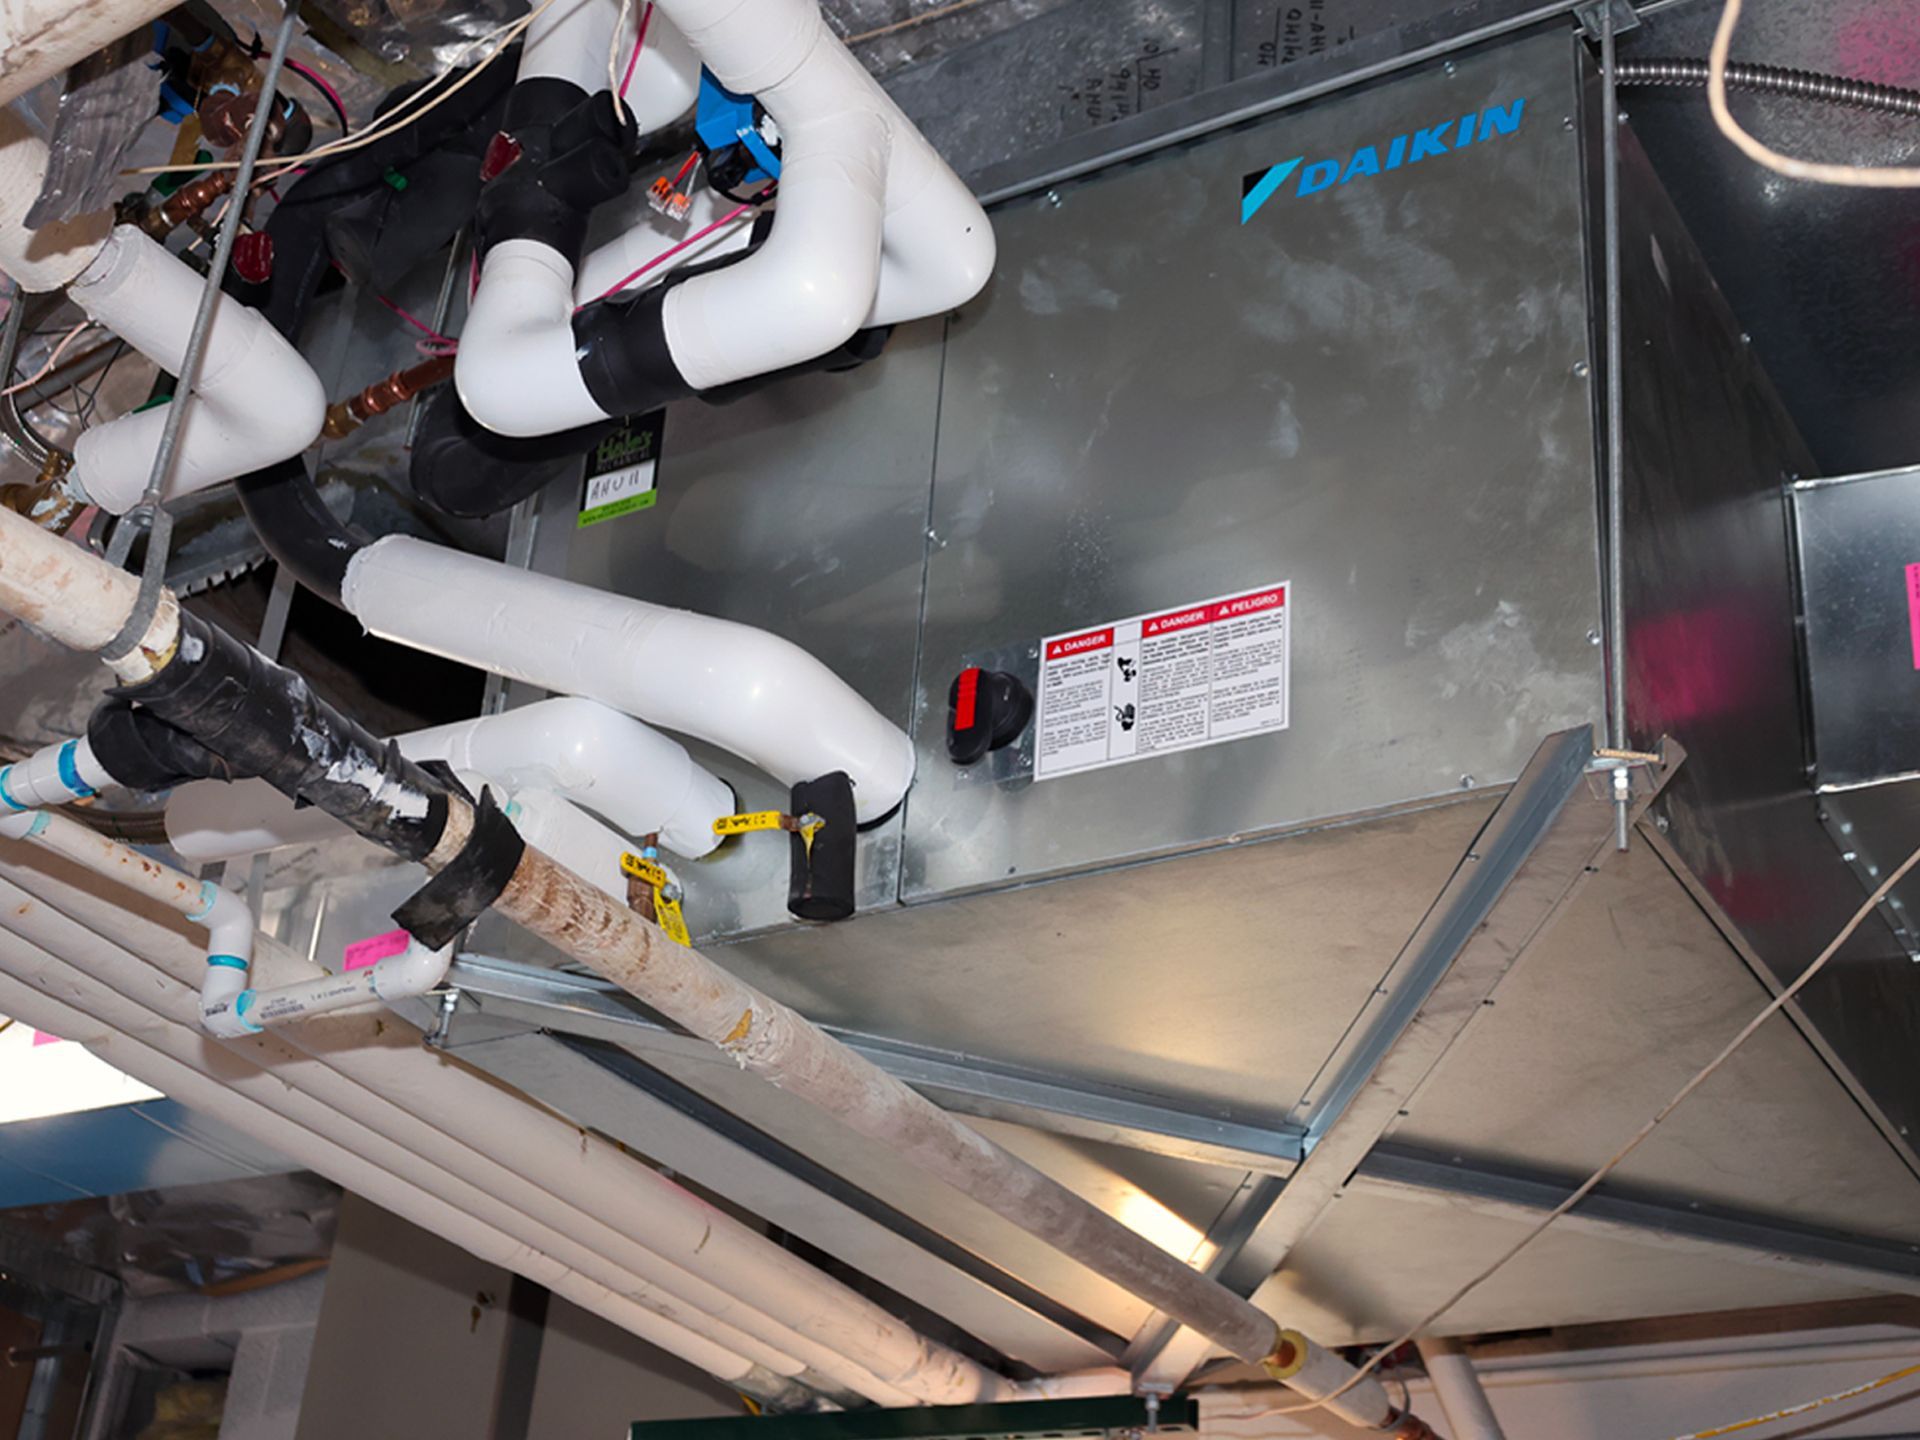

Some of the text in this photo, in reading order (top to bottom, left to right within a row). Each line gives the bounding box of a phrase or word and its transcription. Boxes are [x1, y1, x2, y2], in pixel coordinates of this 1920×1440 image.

[1296, 97, 1525, 198] DAIKIN
[590, 475, 624, 500] AHU
[1231, 593, 1279, 612] PELIGRO
[1160, 611, 1205, 629] DANGER
[1064, 634, 1106, 652] DANGER
